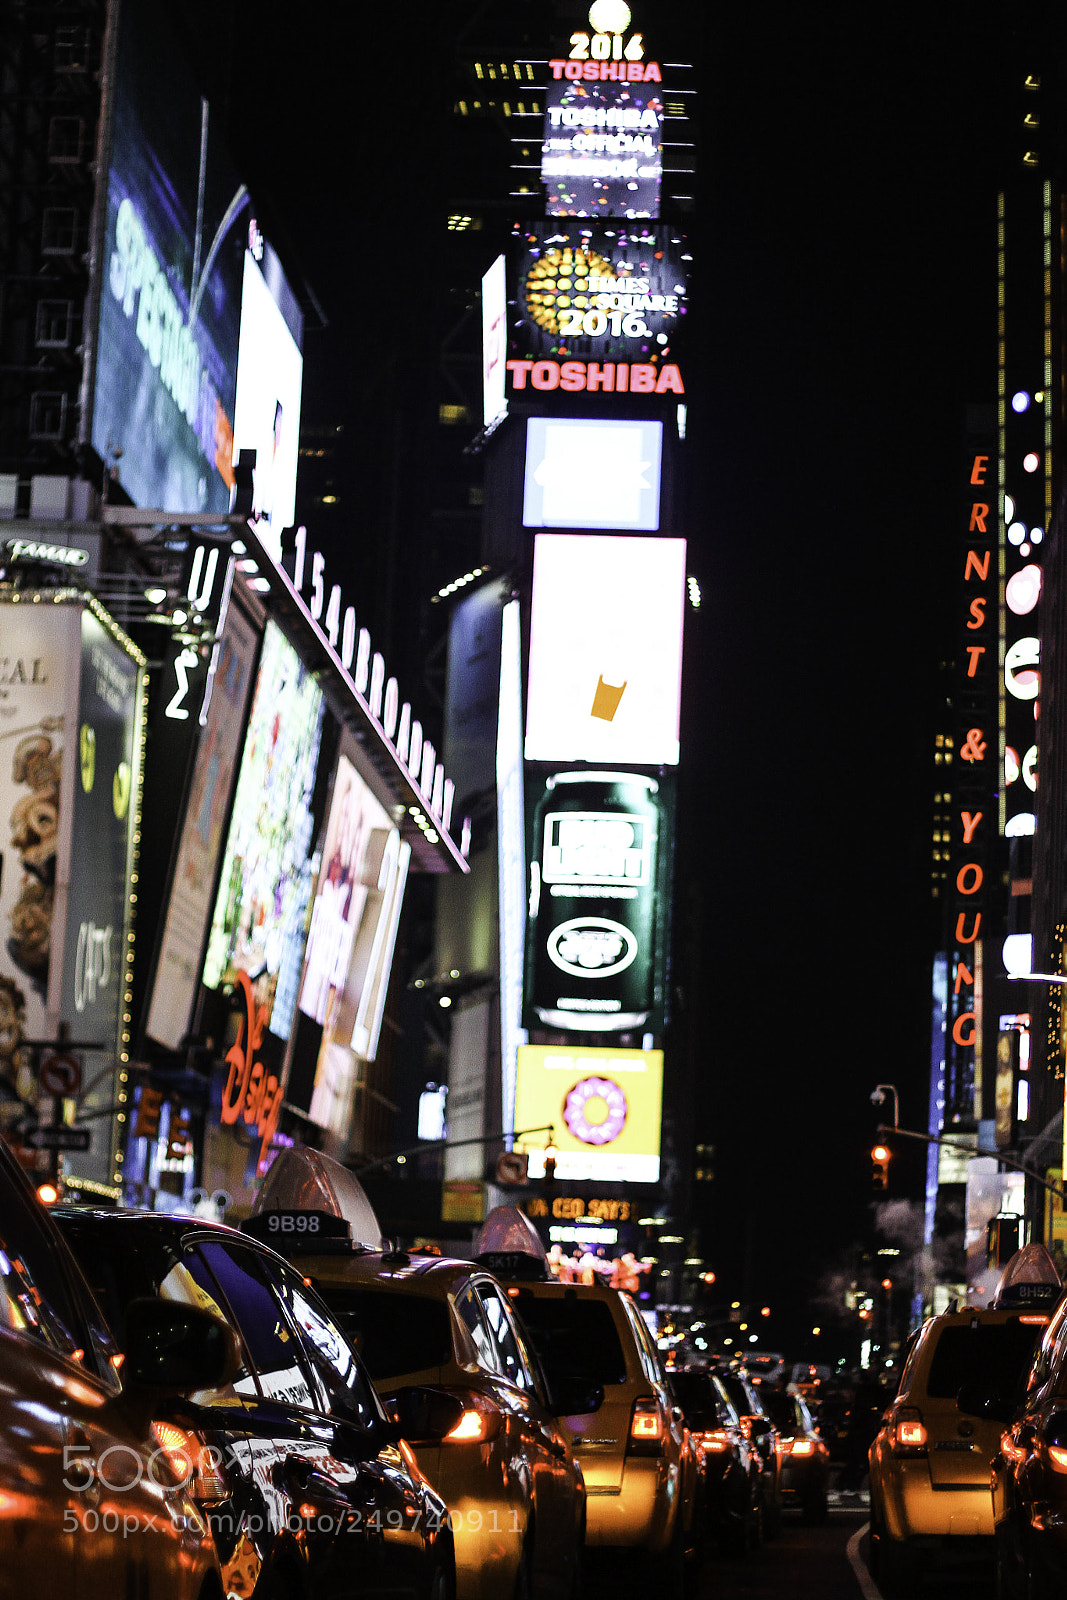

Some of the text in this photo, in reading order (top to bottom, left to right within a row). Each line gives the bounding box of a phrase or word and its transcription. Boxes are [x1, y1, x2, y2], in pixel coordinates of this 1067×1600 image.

[569, 32, 644, 60] 2016
[549, 60, 662, 82] TOSHIBA
[547, 107, 659, 128] TOSHIBA
[585, 277, 649, 294] TIMES
[596, 294, 678, 311] SQUARE
[506, 360, 685, 394] TOSHIBA
[964, 455, 990, 677] ERNST
[960, 728, 987, 761] &
[268, 1215, 320, 1232] 9B98
